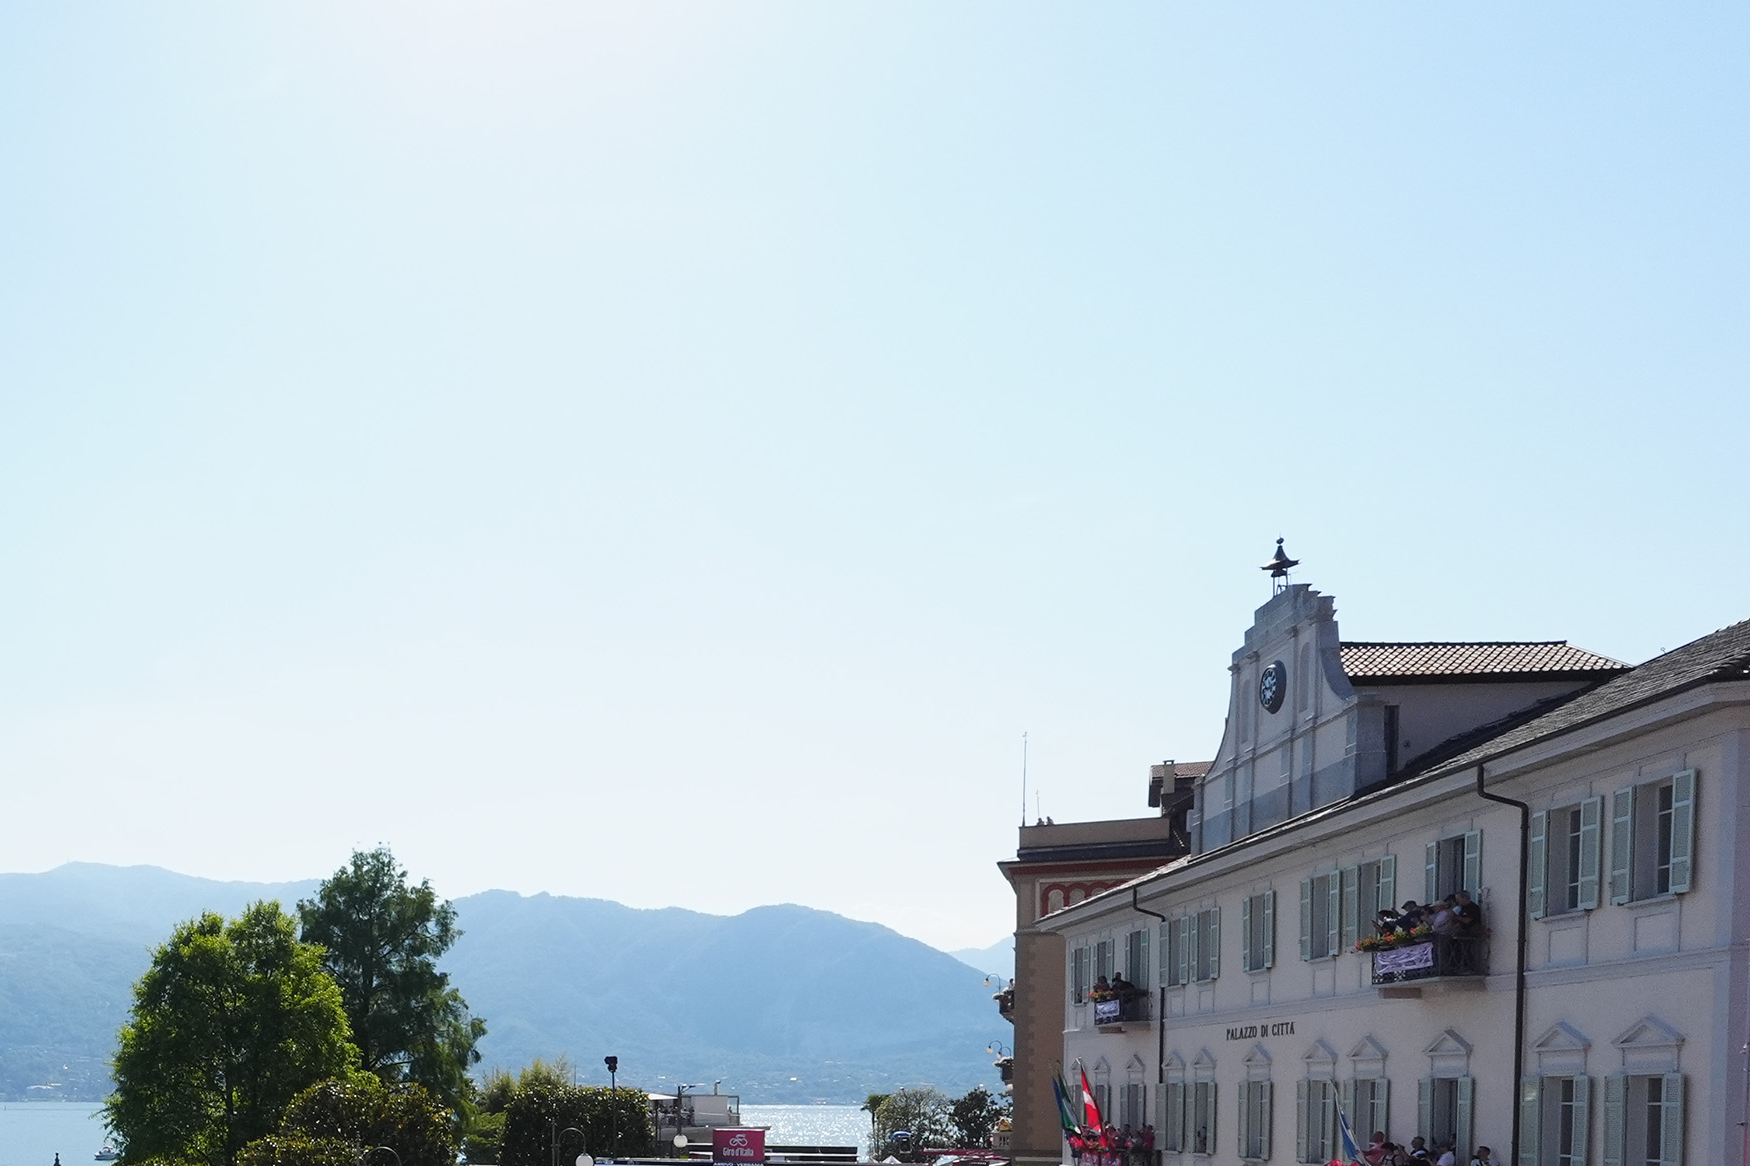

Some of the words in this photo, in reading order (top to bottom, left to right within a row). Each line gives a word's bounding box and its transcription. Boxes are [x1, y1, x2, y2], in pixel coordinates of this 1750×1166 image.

[1226, 1026, 1257, 1040] PALAZZO
[1261, 1025, 1268, 1037] DI
[723, 1147, 735, 1156] Giro
